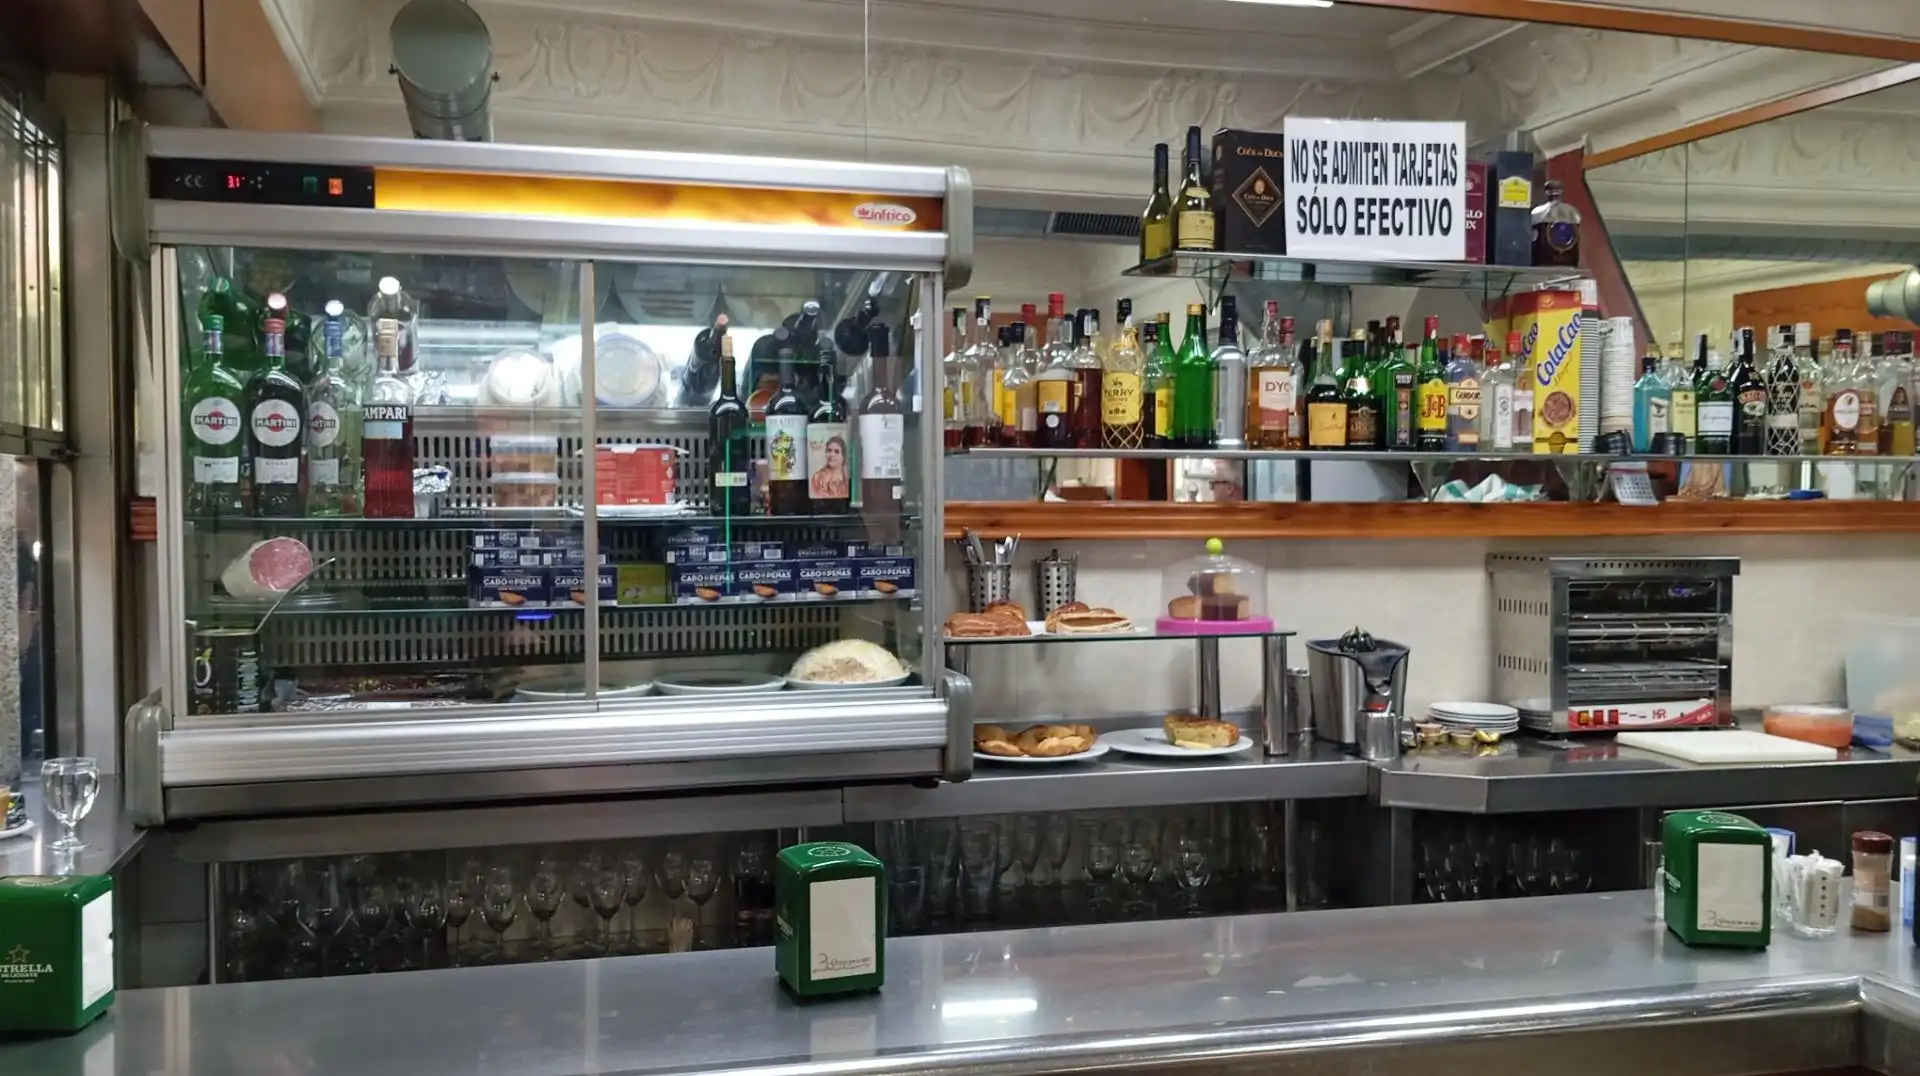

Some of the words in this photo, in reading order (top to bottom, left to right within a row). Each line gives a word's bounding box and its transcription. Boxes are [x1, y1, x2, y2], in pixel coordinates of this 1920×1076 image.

[1291, 139, 1309, 183] NO
[1312, 140, 1328, 184] SE
[1331, 141, 1388, 185] ADMITEN
[1392, 142, 1458, 186] TARJETAS
[1296, 186, 1347, 236] SÓLO
[1354, 197, 1453, 236] EFECTIVO
[1466, 209, 1483, 219] GLO
[1465, 220, 1477, 230] IX
[1520, 321, 1539, 364] aCao
[1536, 312, 1581, 387] ColaCao
[1104, 388, 1134, 397] TERRY
[1421, 394, 1447, 419] J&B
[195, 415, 237, 426] MARTINI
[255, 417, 297, 429] MARTINI
[309, 418, 336, 428] ARTINI
[738, 571, 761, 580] CABO
[799, 569, 821, 578] CABO
[860, 568, 882, 577] CABO
[483, 578, 508, 586] CABO
[680, 574, 704, 583] CABO
[0, 964, 54, 973] TRELLA
